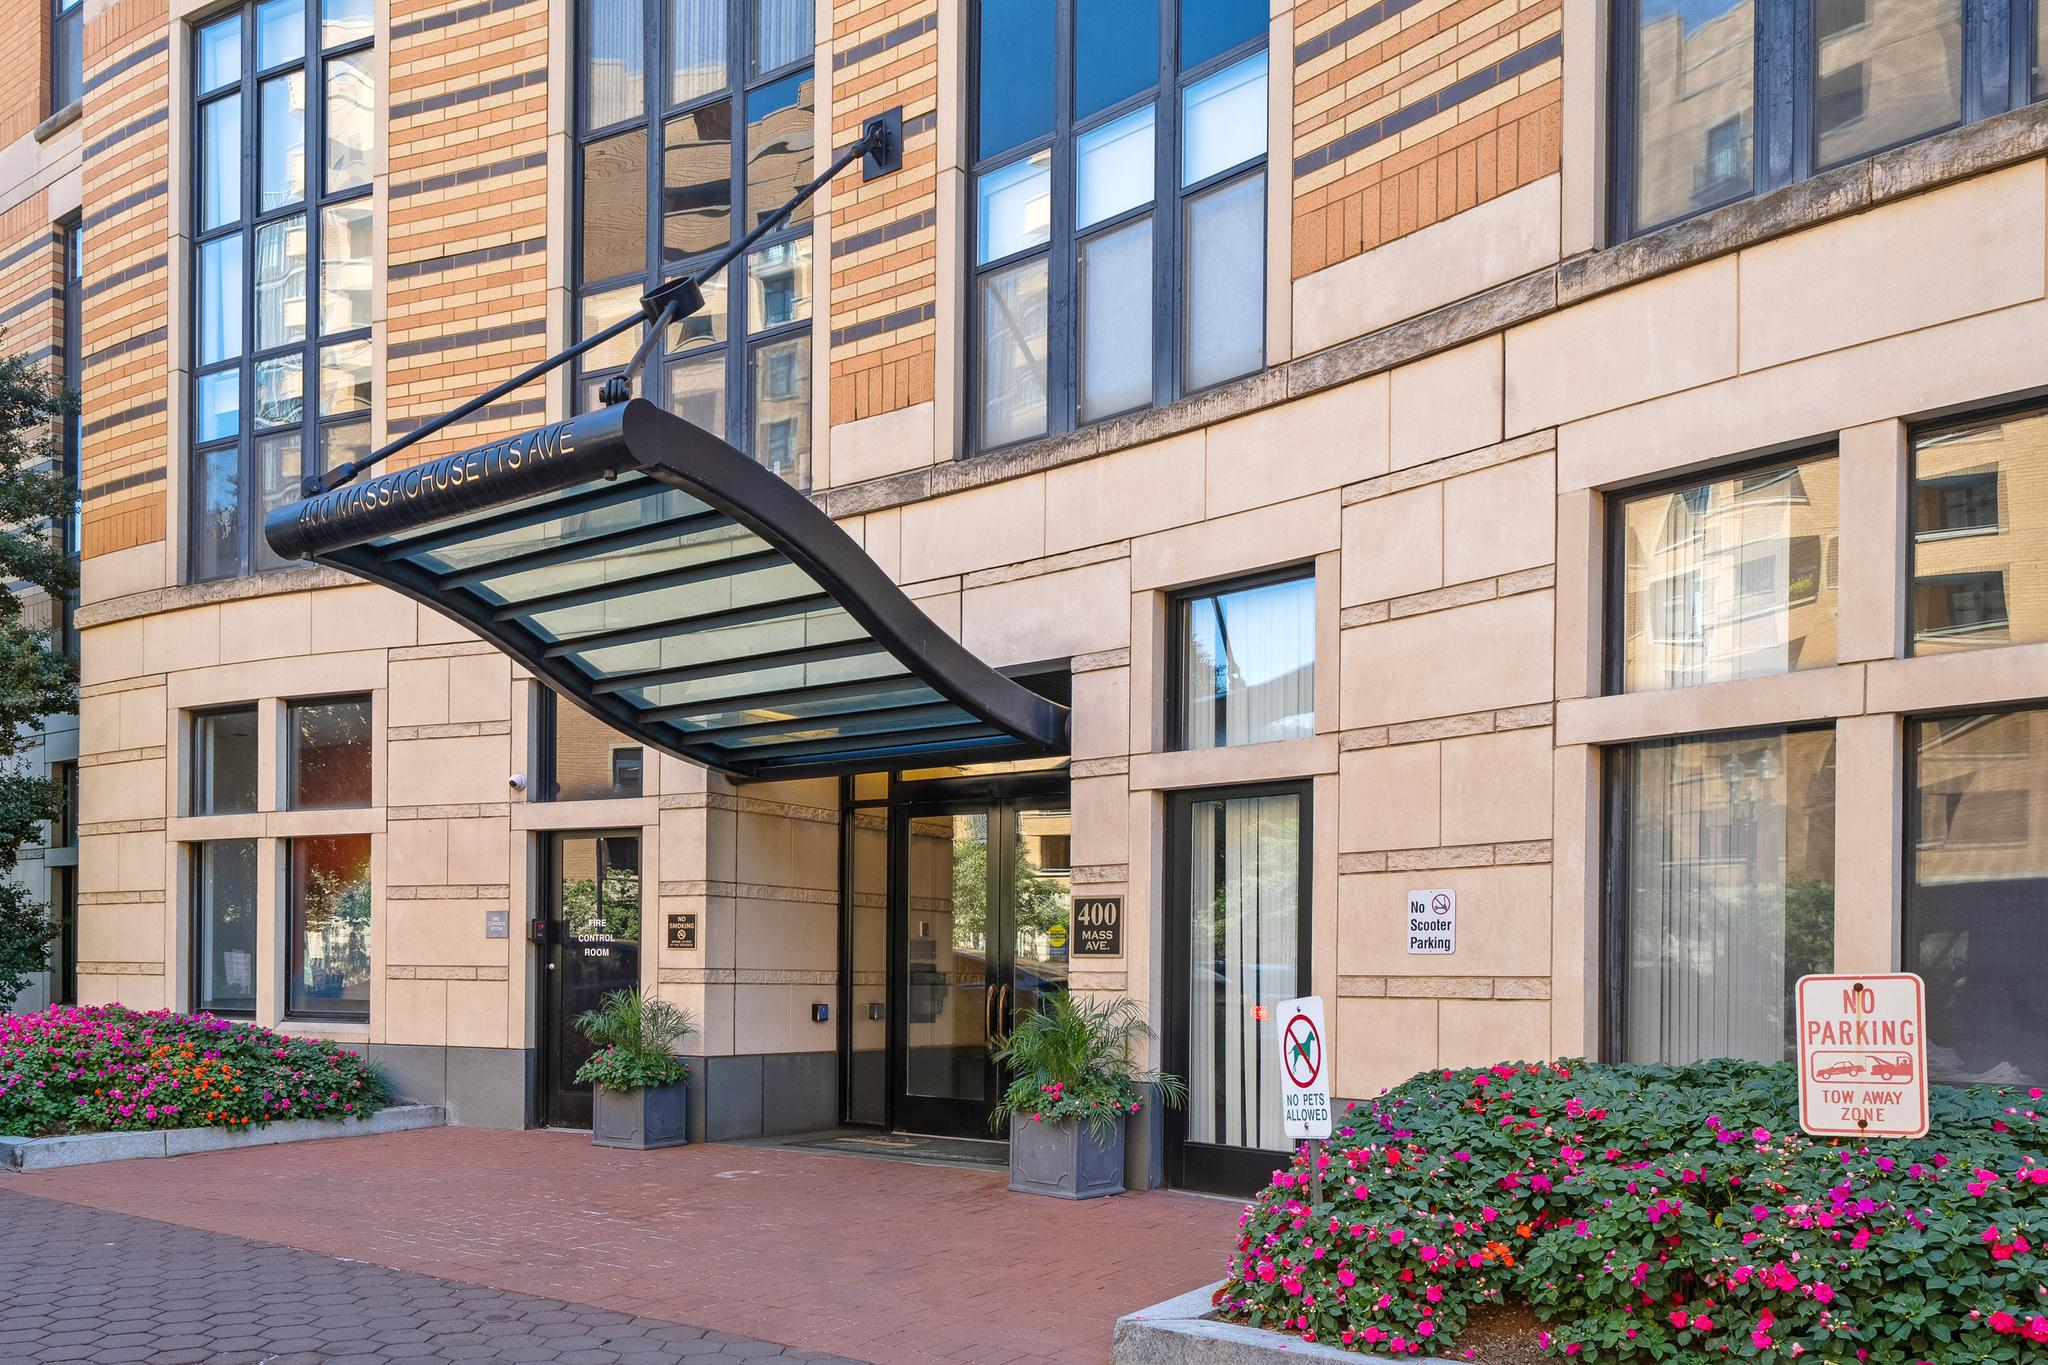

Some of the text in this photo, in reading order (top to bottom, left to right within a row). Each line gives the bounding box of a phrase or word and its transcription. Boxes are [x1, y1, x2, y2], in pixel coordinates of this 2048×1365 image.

[299, 421, 575, 528] 400 MASSACHUSETTS AVE
[1078, 903, 1116, 925] 400
[1410, 901, 1425, 914] No
[588, 918, 607, 927] FIRE
[1410, 919, 1452, 931] Scooter
[578, 934, 616, 942] CONTROL
[1082, 931, 1113, 940] MASS
[1085, 941, 1110, 950] AVE.
[1410, 937, 1451, 952] Parking
[584, 948, 610, 957] ROOM
[1843, 988, 1875, 1014] NO
[1808, 1020, 1914, 1046] PARKING
[1286, 1093, 1325, 1106] NO PETS
[1822, 1090, 1903, 1105] TOW AWAY
[1286, 1109, 1328, 1121] ALLOWED
[1841, 1107, 1886, 1122] ZONE
